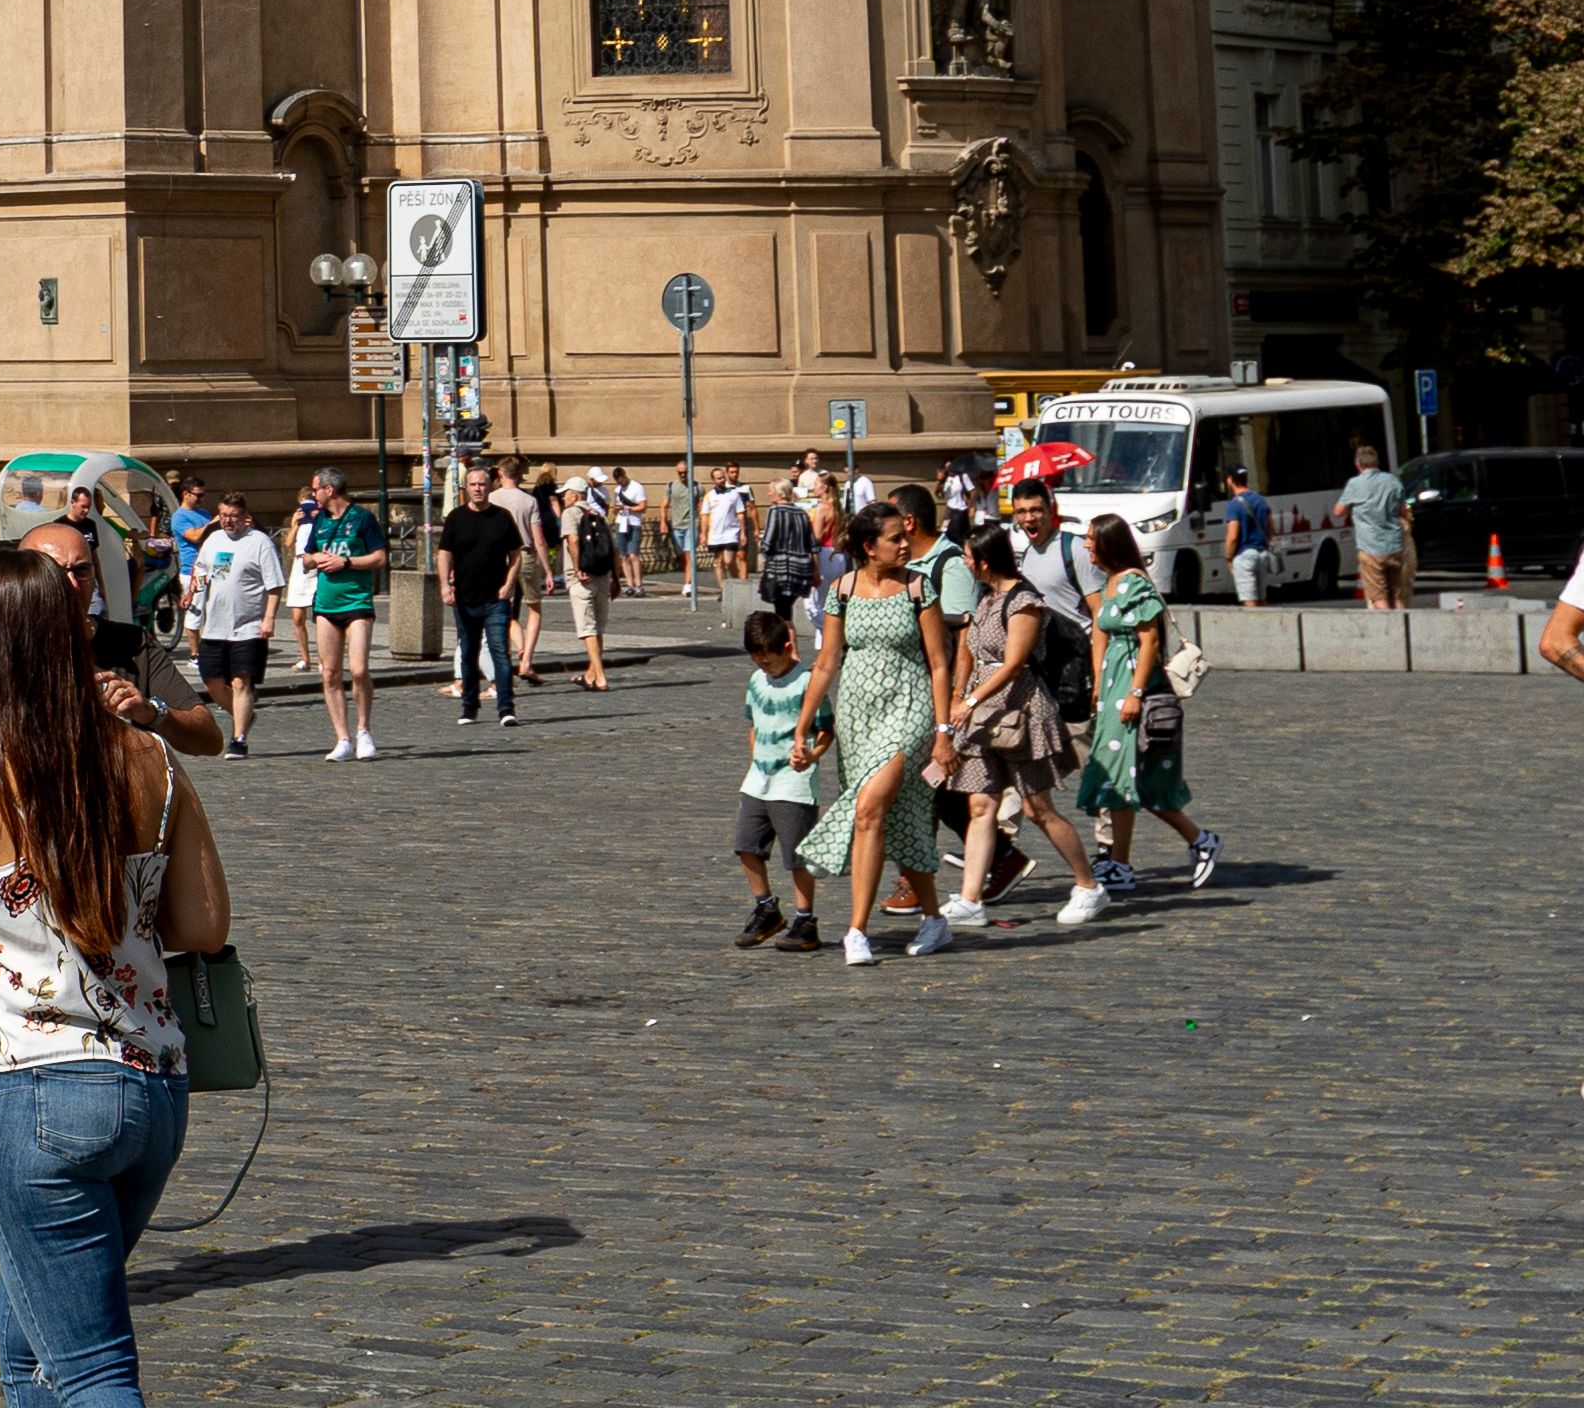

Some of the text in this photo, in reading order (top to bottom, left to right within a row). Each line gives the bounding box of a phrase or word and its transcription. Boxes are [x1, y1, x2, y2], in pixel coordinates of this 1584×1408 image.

[399, 190, 425, 206] PĚŠÍ
[1055, 404, 1176, 420] CITY TOURS
